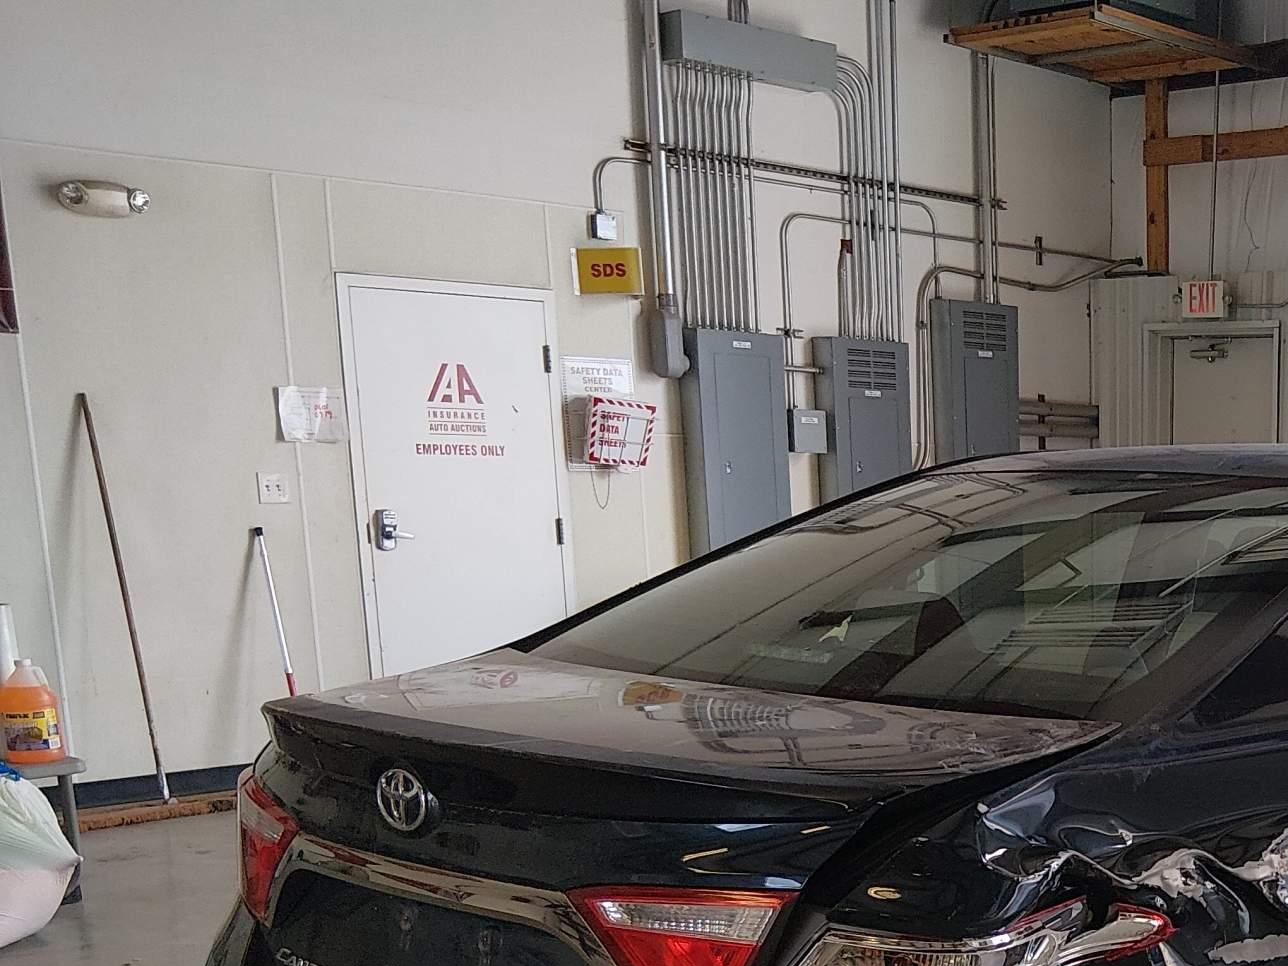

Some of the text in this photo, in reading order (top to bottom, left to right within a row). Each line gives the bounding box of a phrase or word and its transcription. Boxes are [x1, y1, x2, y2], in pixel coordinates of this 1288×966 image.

[591, 262, 626, 278] SDS
[1189, 282, 1217, 313] EXIT
[570, 366, 624, 376] SAFETY DATA
[582, 377, 613, 385] SHEETS
[427, 410, 486, 420] INSURANCE
[429, 423, 487, 433] AUTO AUCTIONS
[599, 423, 620, 434] DATA
[416, 443, 505, 456] EMPLOYEES ONLY
